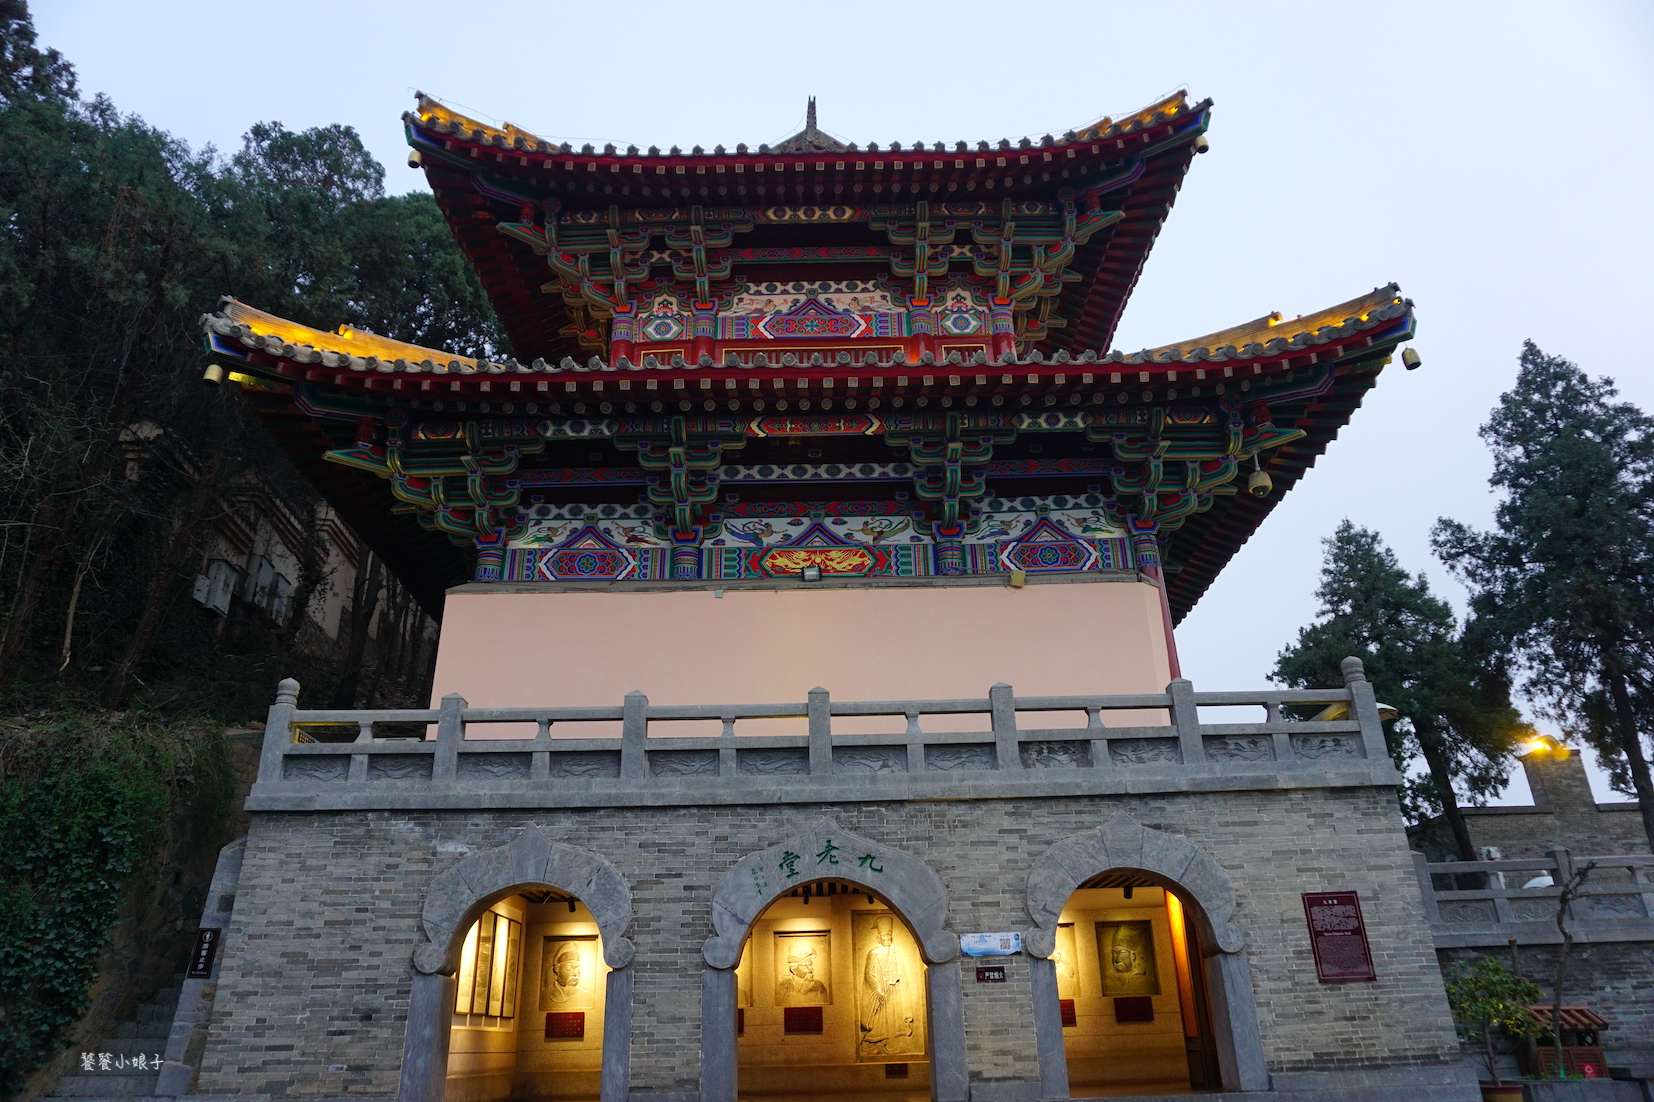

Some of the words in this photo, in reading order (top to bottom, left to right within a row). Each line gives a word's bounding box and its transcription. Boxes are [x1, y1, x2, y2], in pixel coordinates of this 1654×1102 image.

[197, 943, 210, 970] 游客止步
[984, 971, 1004, 980] 严禁烟火
